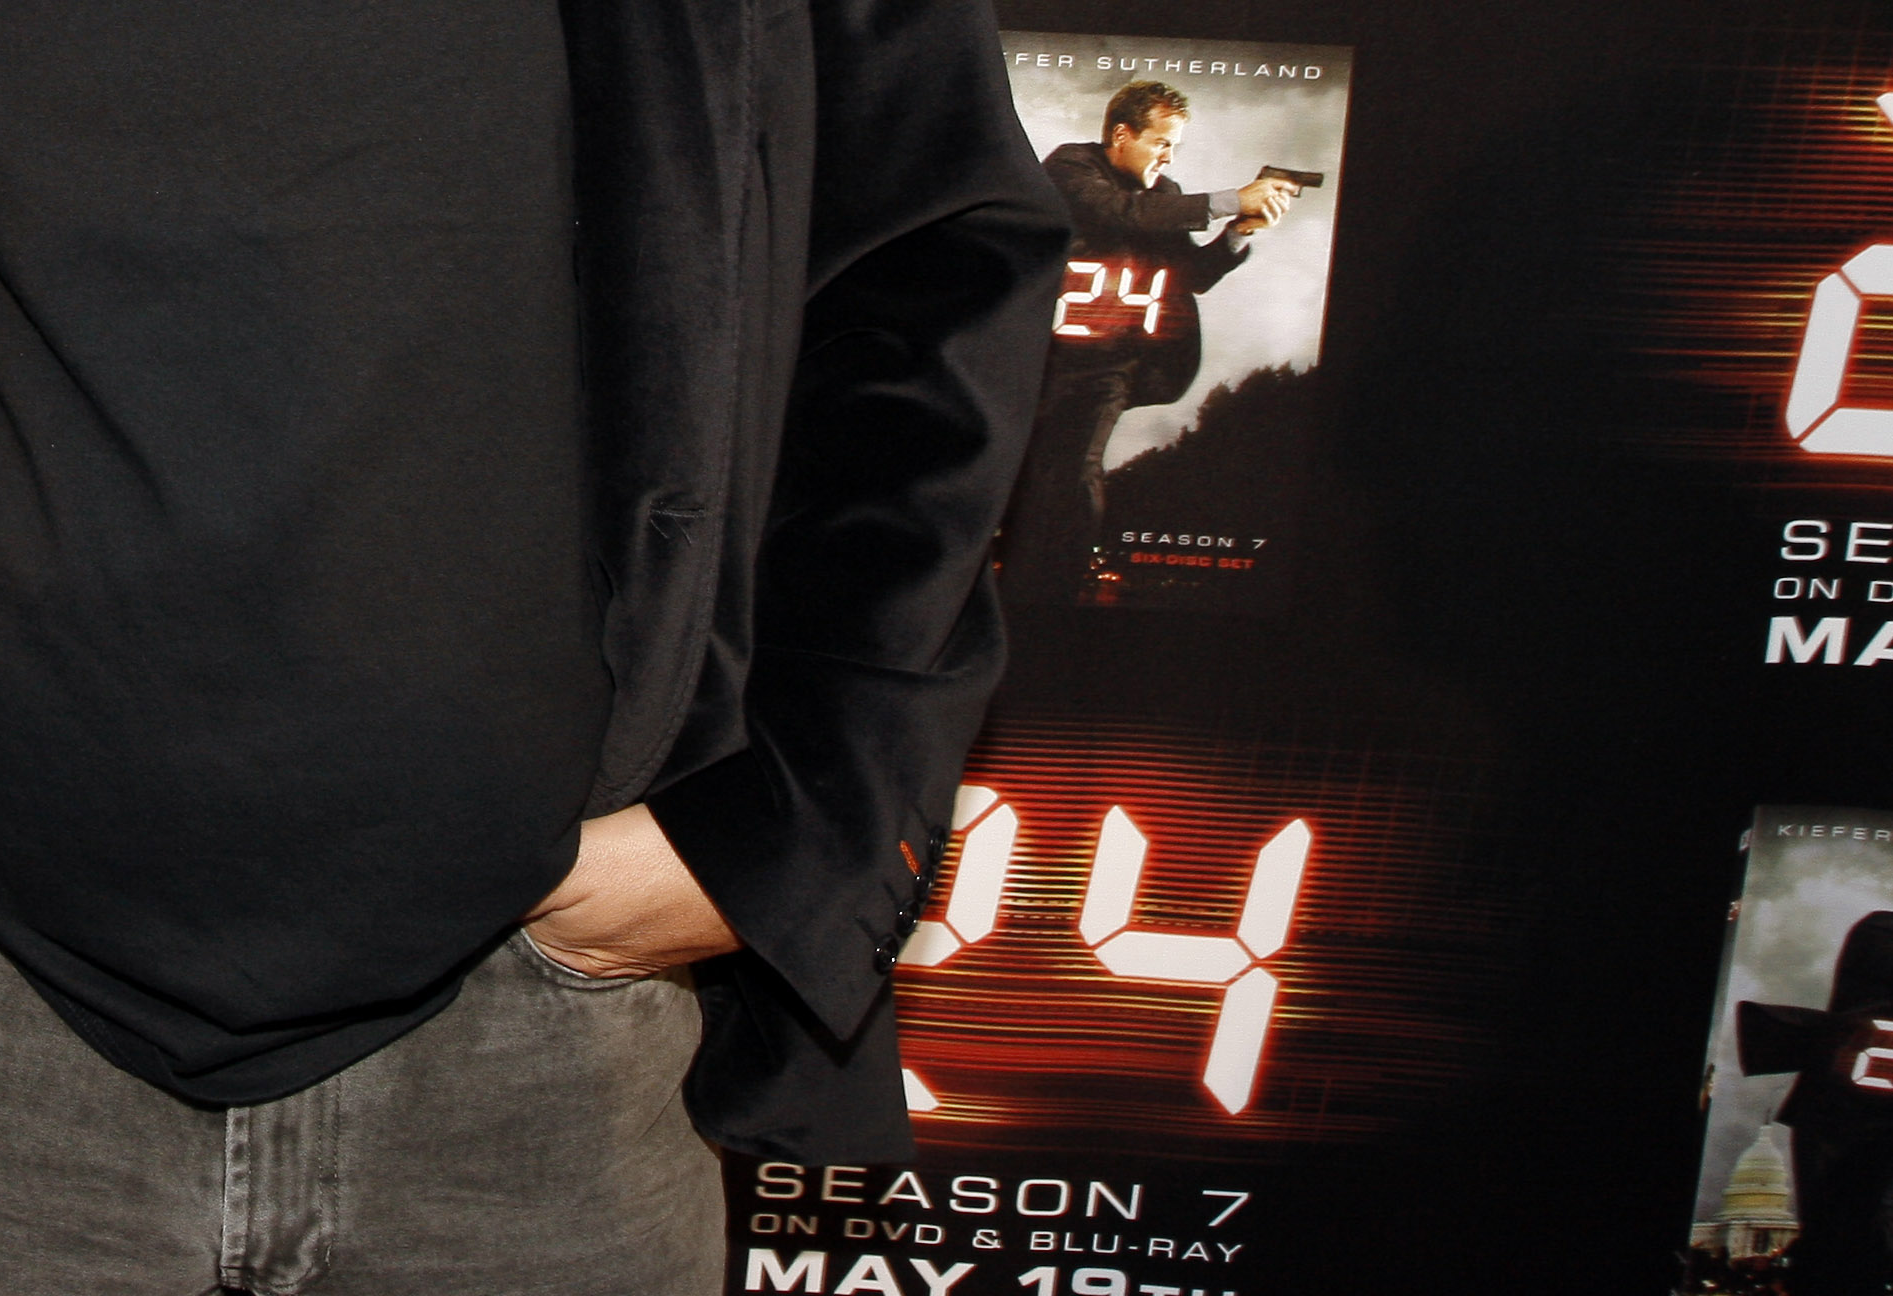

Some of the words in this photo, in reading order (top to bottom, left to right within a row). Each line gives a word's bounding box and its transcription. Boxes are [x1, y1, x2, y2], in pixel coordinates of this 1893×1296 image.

[1003, 51, 1073, 68] FER
[1097, 56, 1322, 80] SUTHERLAND
[1052, 261, 1167, 337] 24
[1121, 531, 1233, 548] SEASON
[1252, 538, 1266, 550] 7
[1774, 577, 1839, 600] ON
[1777, 824, 1890, 841] KIEFER
[758, 1162, 1141, 1220] SEASON
[1202, 1189, 1249, 1227] 7
[751, 1213, 817, 1235] ON
[847, 1218, 943, 1245] DVD
[971, 1228, 1002, 1249] &
[1029, 1230, 1242, 1263] BLU-RAY
[744, 1248, 975, 1296] MAY
[1018, 1266, 1235, 1296] 19
